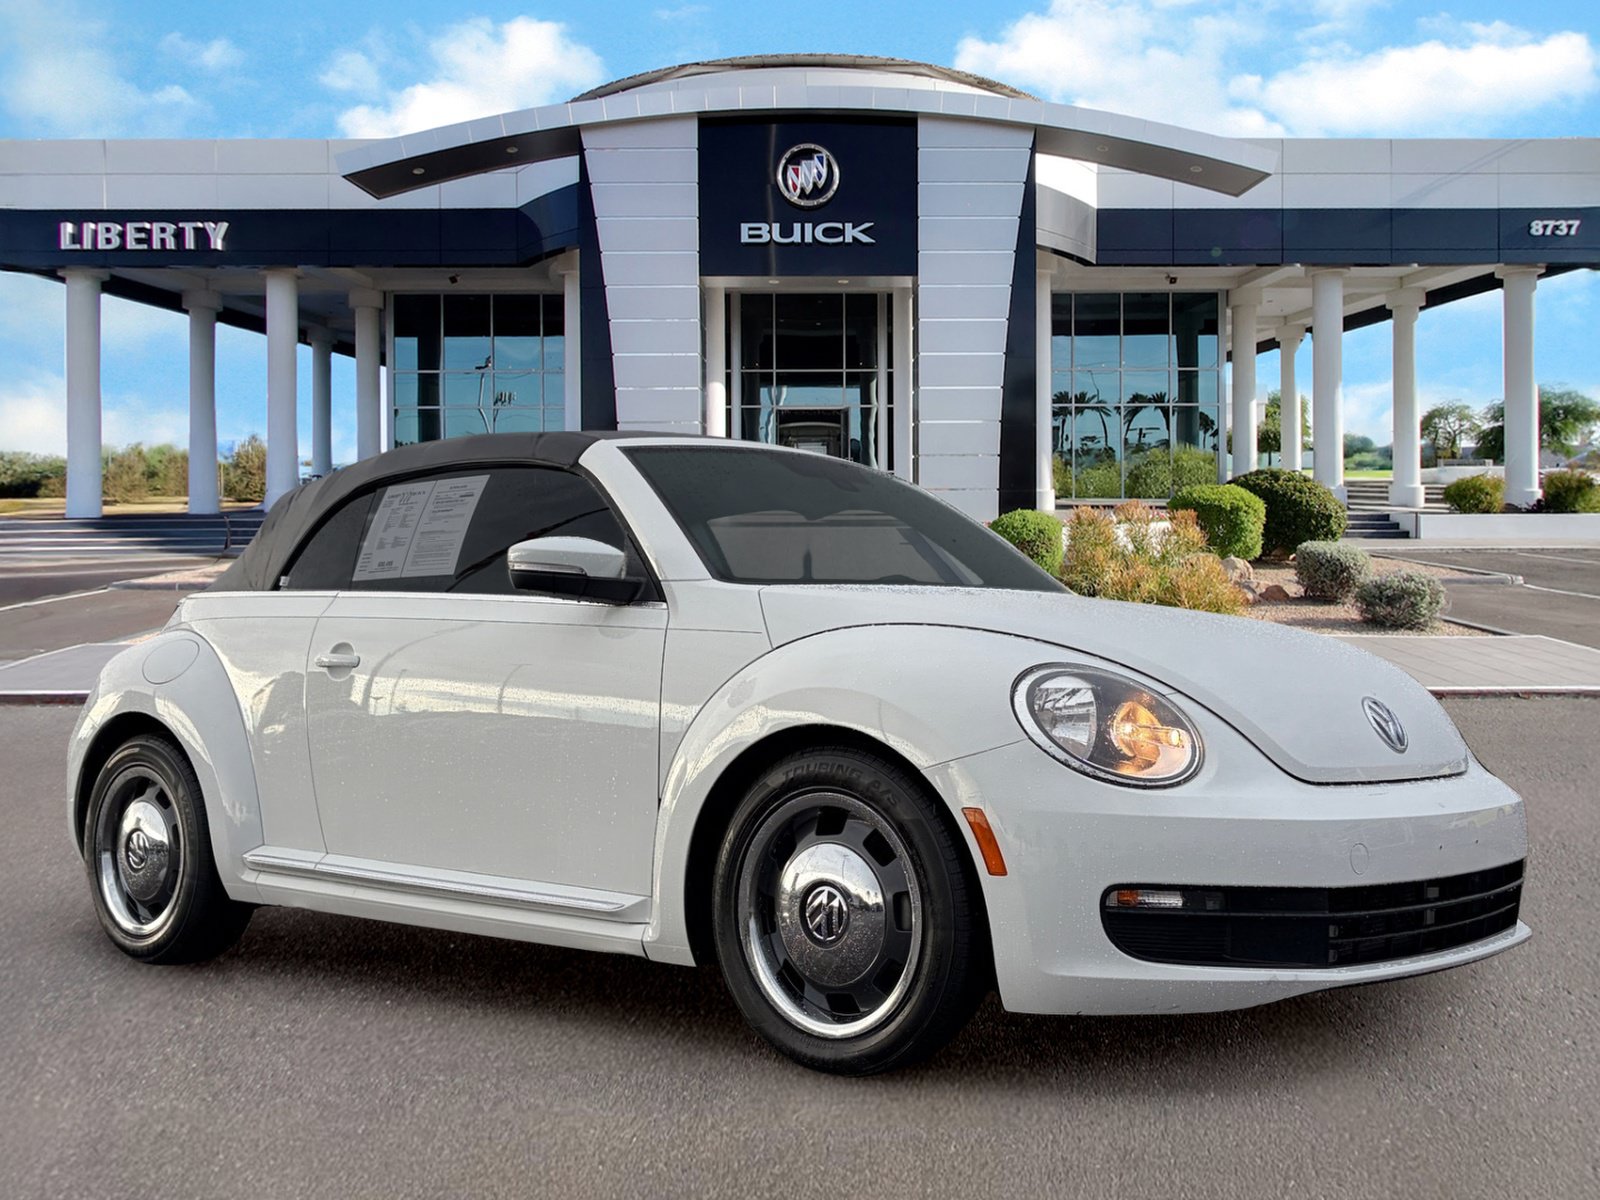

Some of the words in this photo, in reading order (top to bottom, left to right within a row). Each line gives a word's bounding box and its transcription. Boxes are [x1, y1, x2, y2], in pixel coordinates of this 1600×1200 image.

[59, 221, 229, 250] LIBERTY
[740, 222, 876, 243] BUICK
[1529, 219, 1581, 236] 8737
